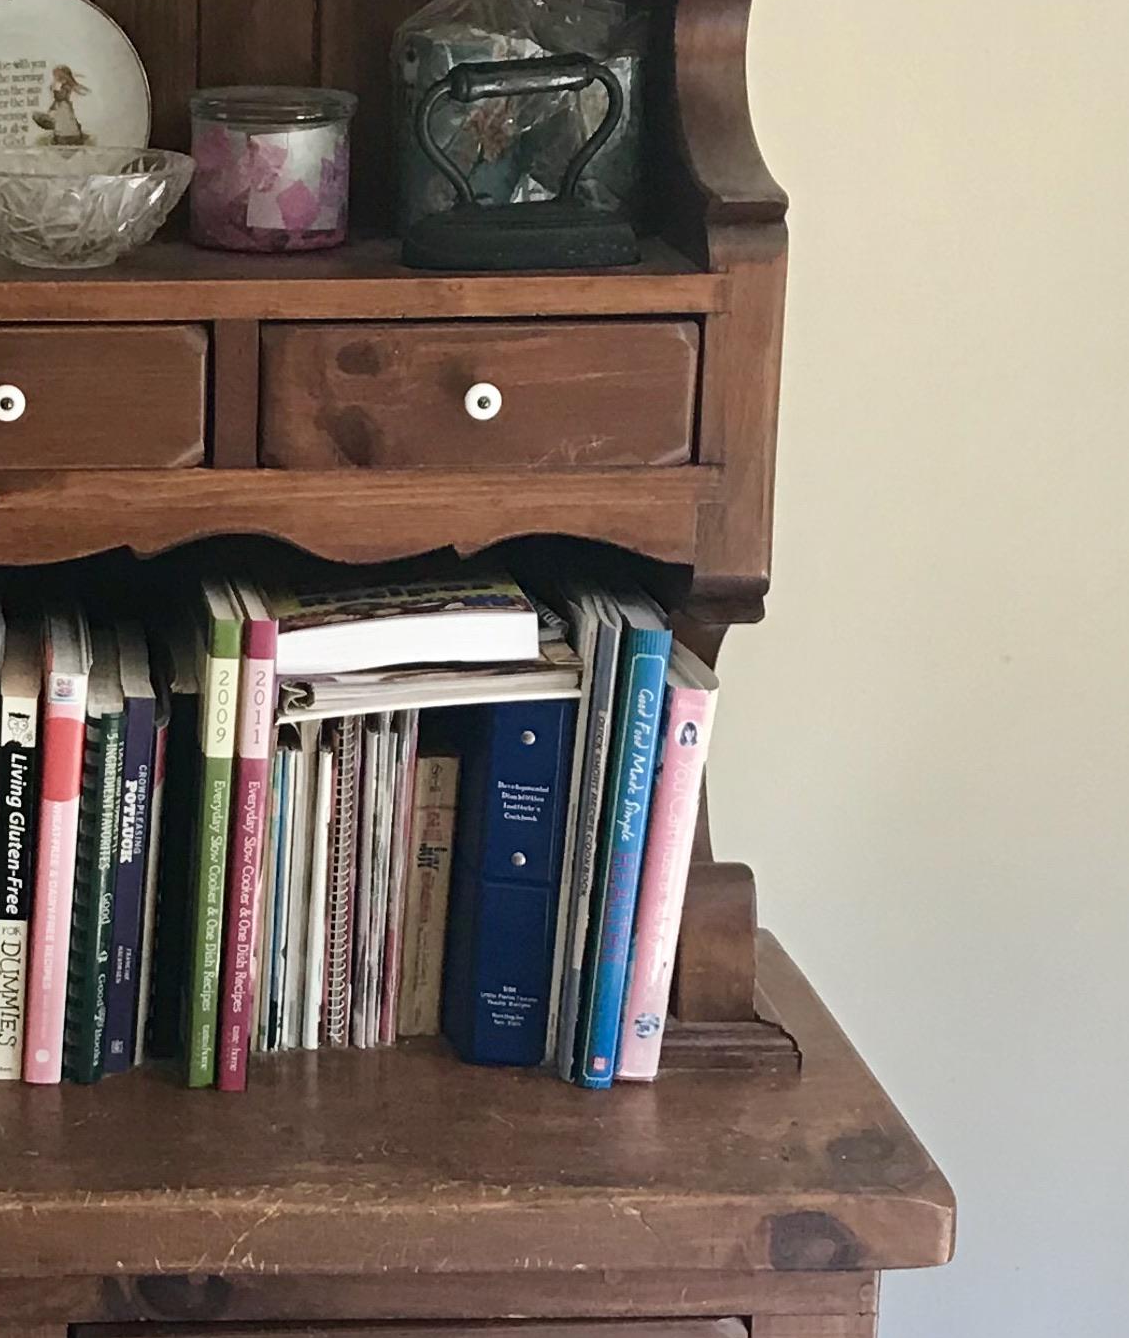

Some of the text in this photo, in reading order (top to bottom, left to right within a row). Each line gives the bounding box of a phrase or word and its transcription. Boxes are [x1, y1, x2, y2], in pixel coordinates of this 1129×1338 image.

[216, 670, 230, 744] 2009
[254, 670, 267, 745] 2011
[133, 764, 148, 855] CROWD-PLEASING
[616, 689, 655, 843] Good Food Made Simple
[5, 753, 28, 915] Living Gluten-Free
[98, 812, 113, 870] FAVORITES
[119, 779, 138, 864] POTLUCK
[200, 780, 226, 1011] Everyday Slow Cooker & One Dish Recipes
[231, 780, 261, 1013] Everyday Slow Cooker & One Dish Recipes
[97, 973, 107, 1006] Good
